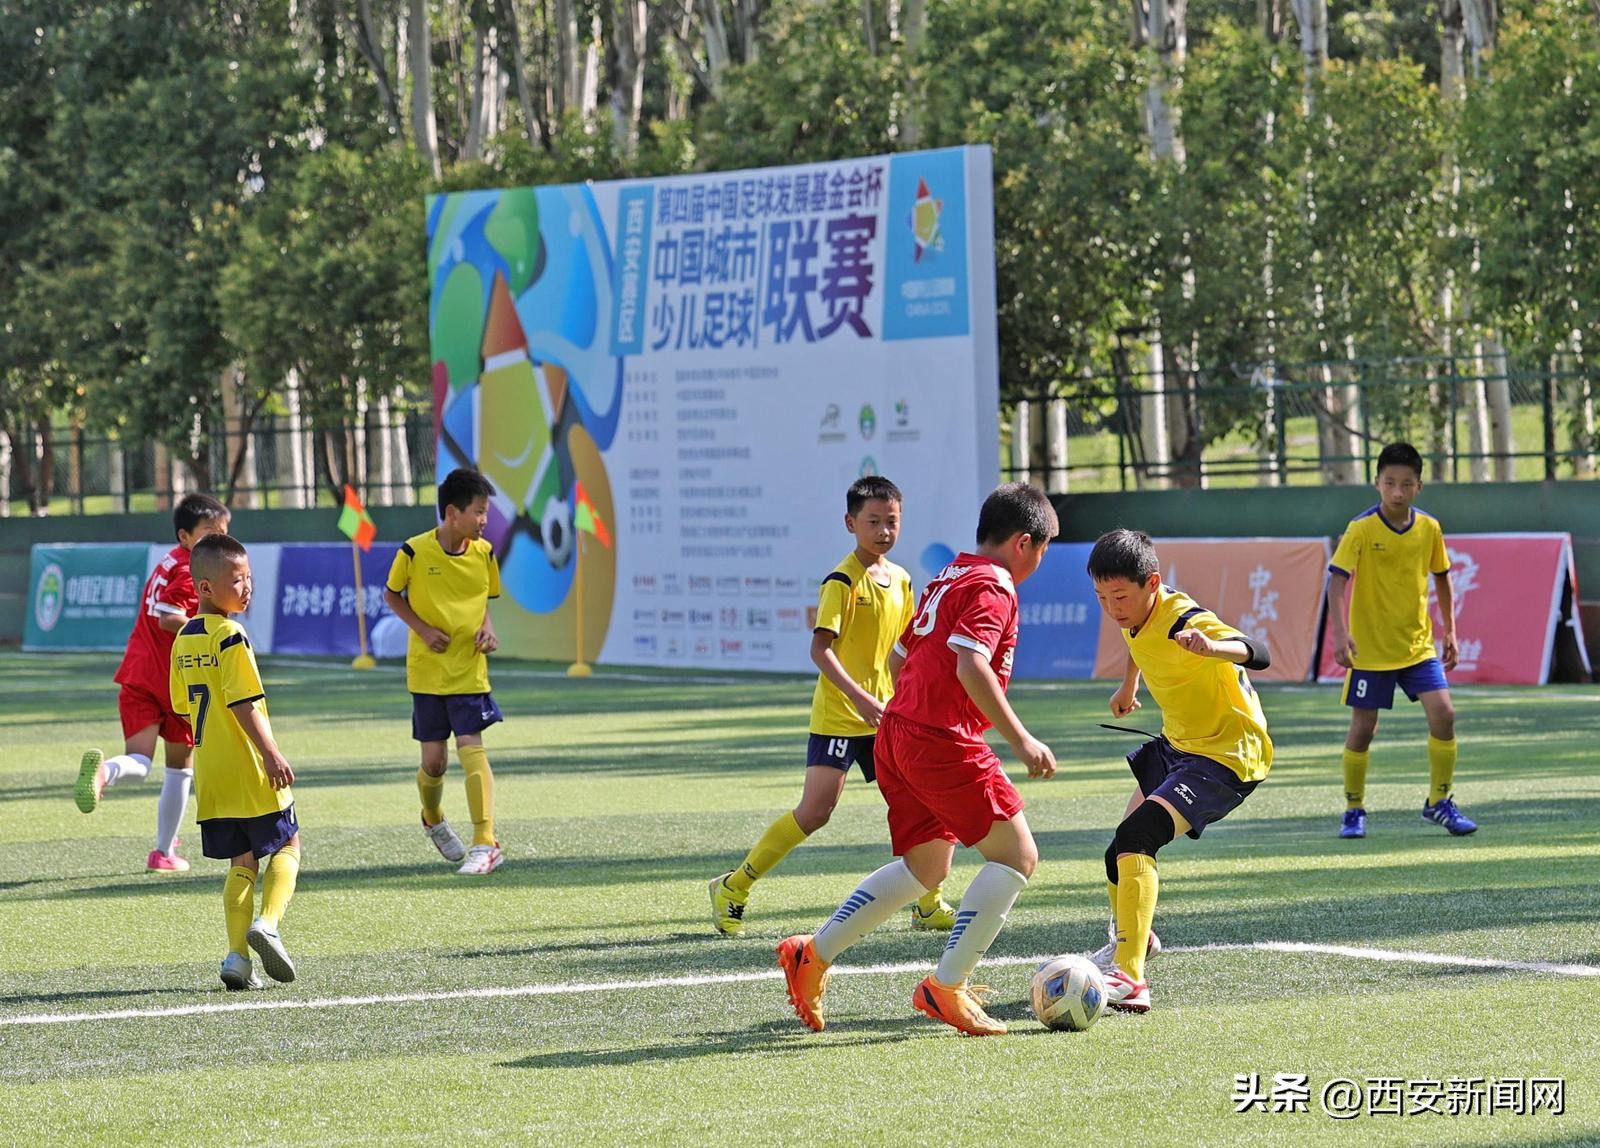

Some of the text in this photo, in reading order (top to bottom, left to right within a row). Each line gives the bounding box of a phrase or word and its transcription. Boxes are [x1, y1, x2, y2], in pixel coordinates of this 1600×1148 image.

[656, 165, 884, 226] 第四届中国足球发展基金会杯
[654, 222, 758, 288] 中国城市
[763, 212, 878, 344] 联赛
[651, 287, 755, 352] 少儿足球
[187, 683, 211, 748] 7
[1356, 678, 1368, 699] 9
[827, 738, 849, 759] 19
